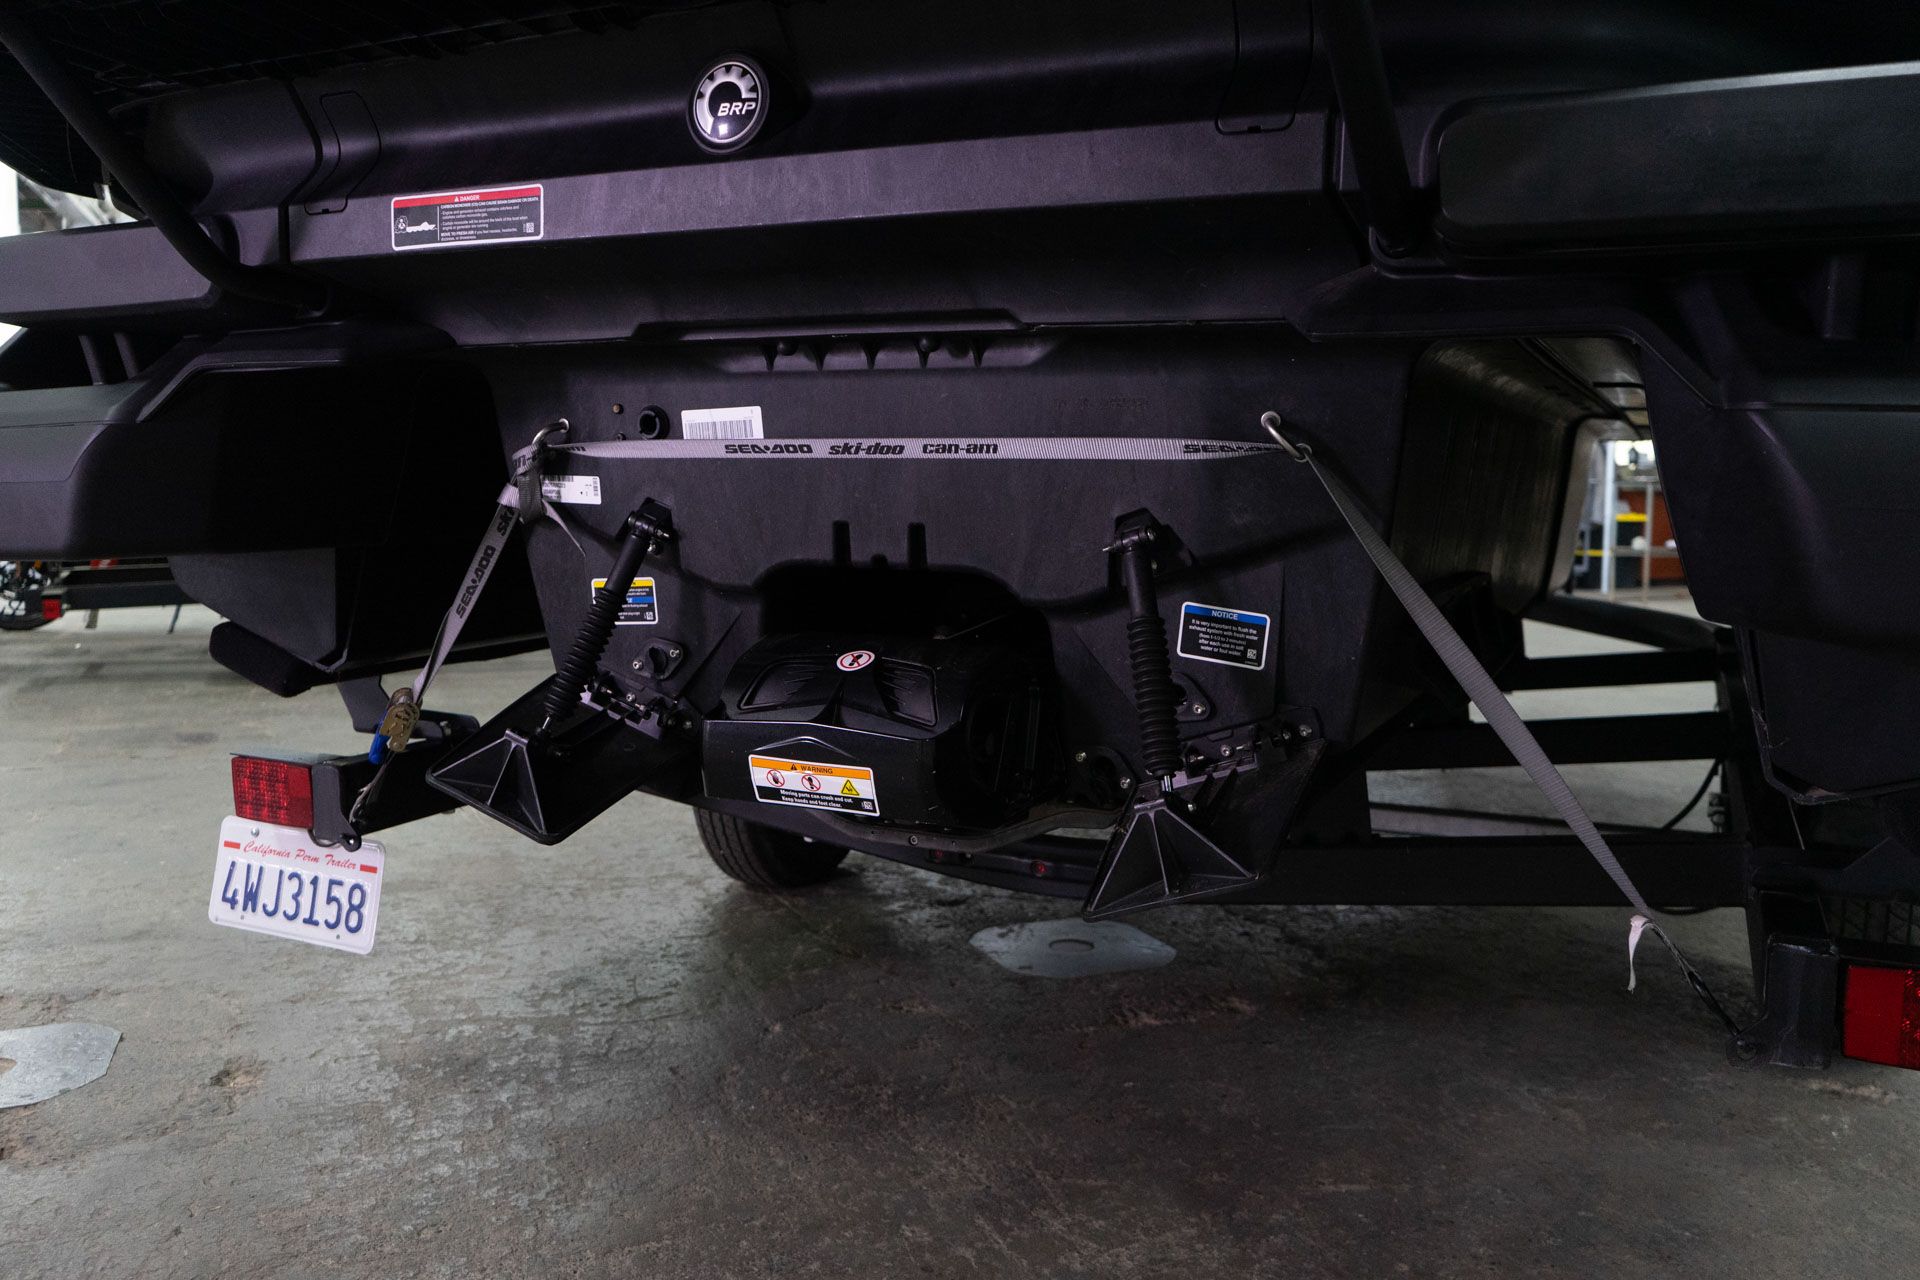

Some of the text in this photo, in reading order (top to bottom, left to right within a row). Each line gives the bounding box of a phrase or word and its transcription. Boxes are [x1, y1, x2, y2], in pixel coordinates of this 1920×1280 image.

[717, 101, 757, 117] BRP
[460, 194, 480, 202] DANGER
[828, 442, 906, 456] ski-doo
[922, 443, 999, 455] can-am
[1211, 610, 1238, 621] NOTICE
[801, 765, 833, 775] WARNING
[243, 841, 357, 870] California Perm Trailer
[221, 861, 367, 934] 4WJ3158
